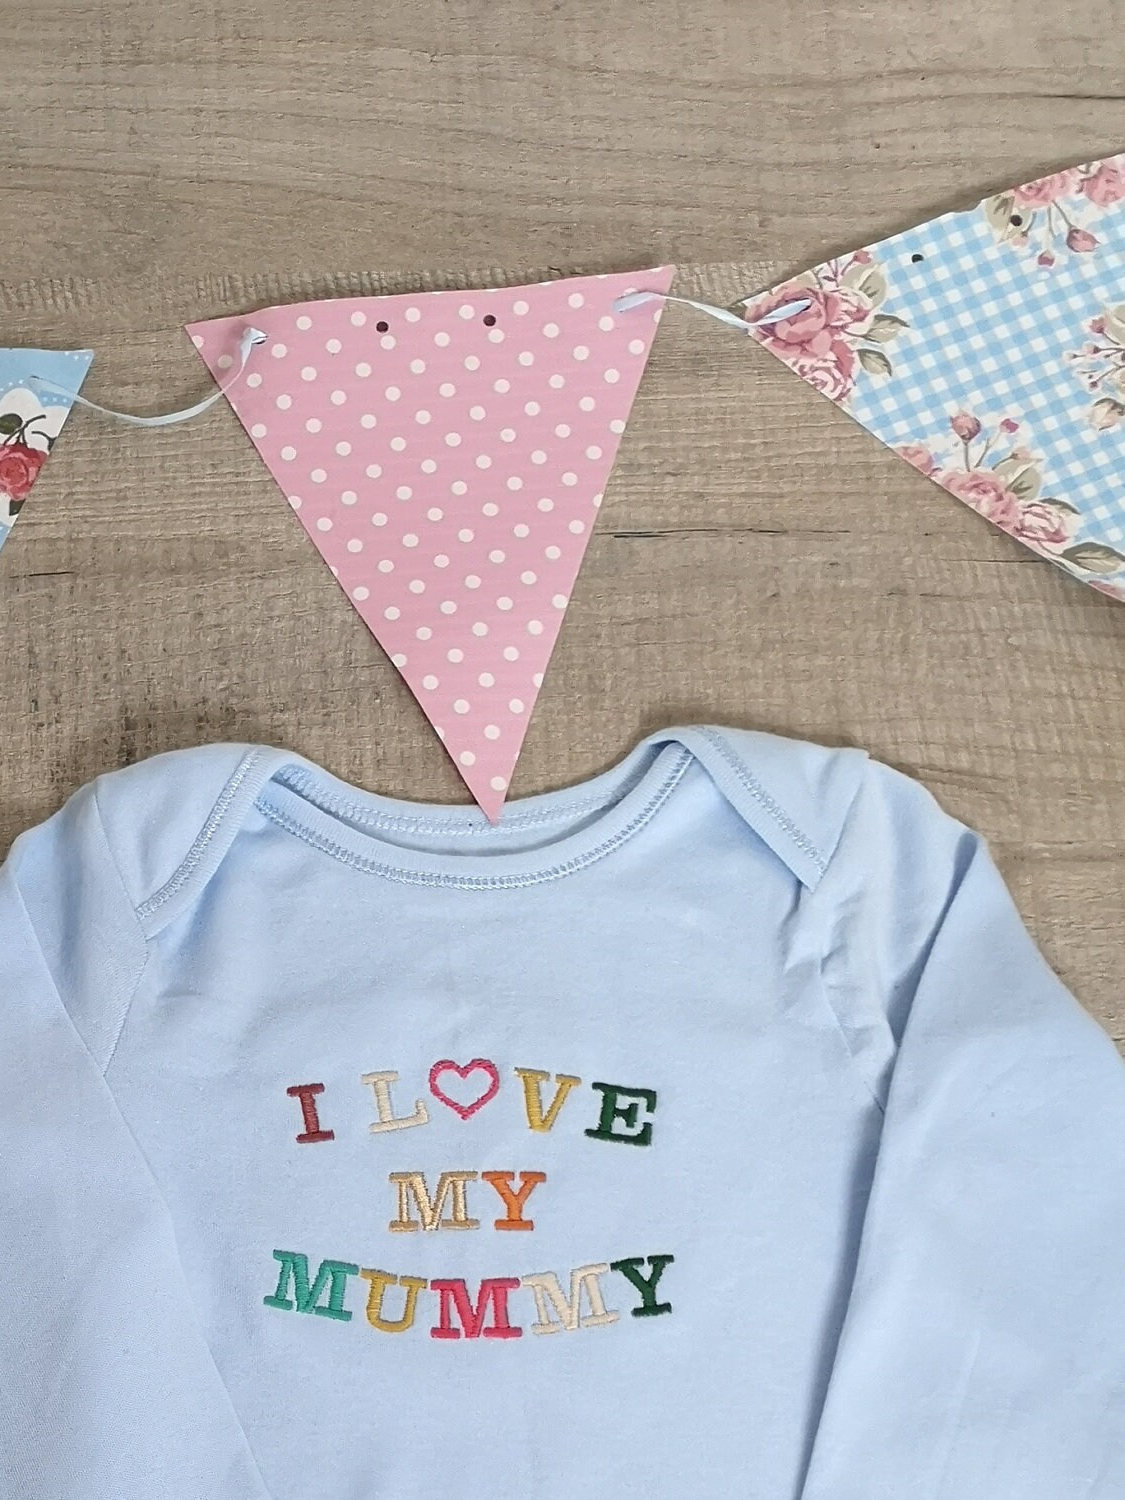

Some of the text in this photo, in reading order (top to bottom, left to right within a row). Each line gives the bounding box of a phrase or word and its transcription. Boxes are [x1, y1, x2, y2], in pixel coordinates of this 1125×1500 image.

[286, 1082, 335, 1144] I
[388, 1171, 547, 1232] MY
[263, 1249, 675, 1340] MUMMY
